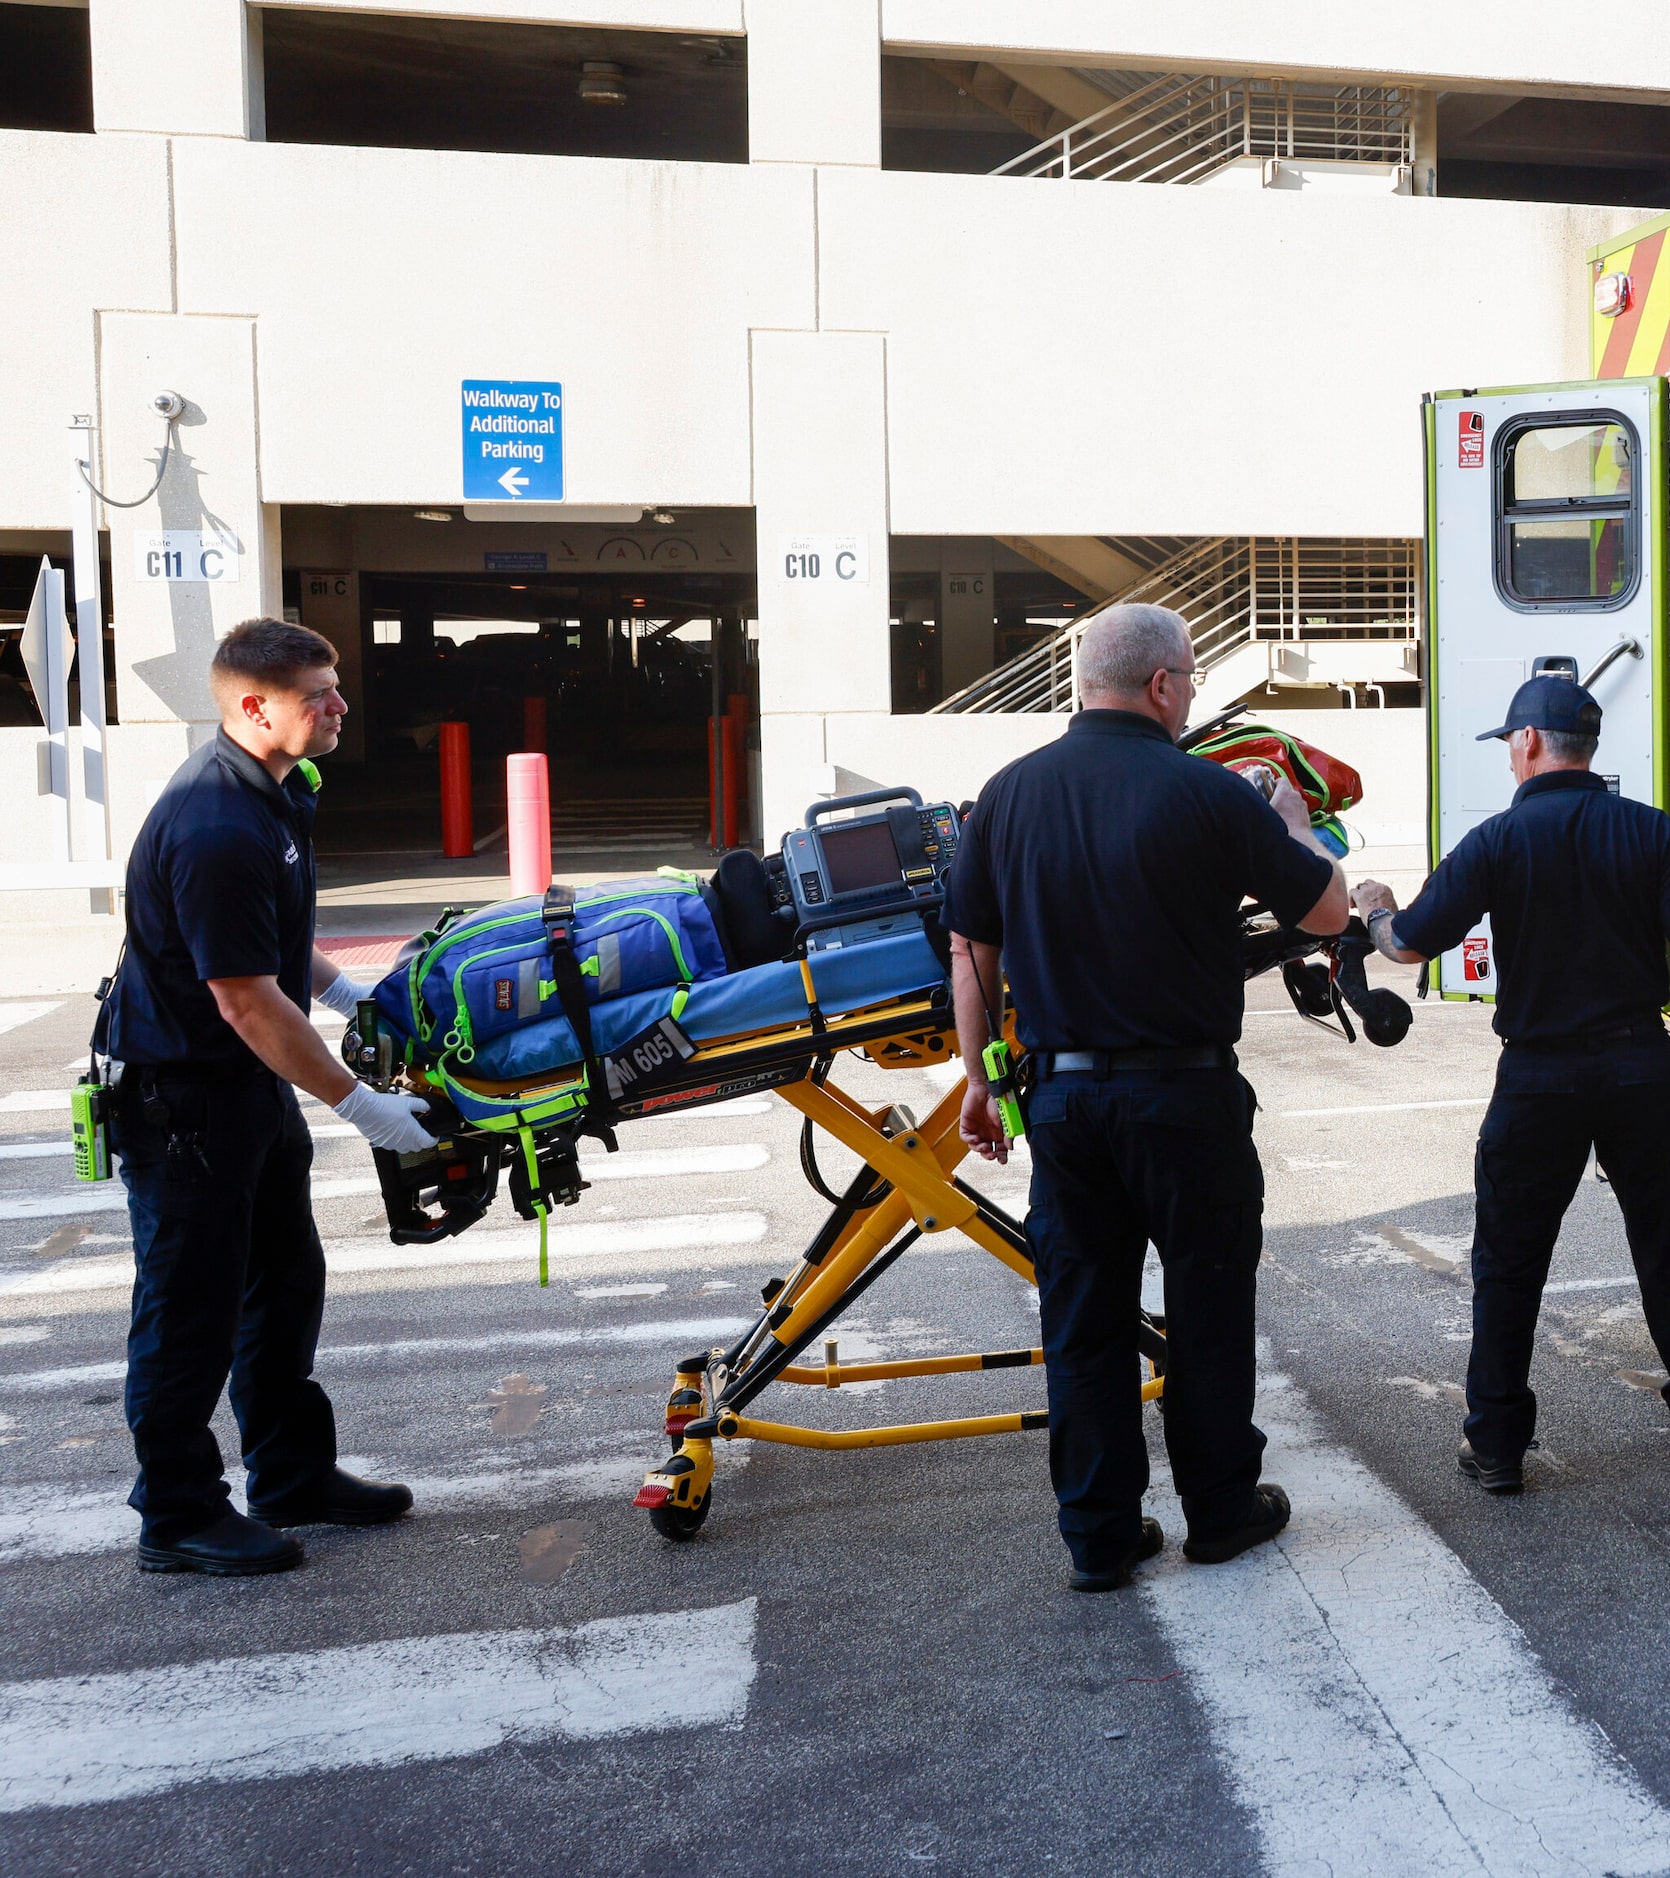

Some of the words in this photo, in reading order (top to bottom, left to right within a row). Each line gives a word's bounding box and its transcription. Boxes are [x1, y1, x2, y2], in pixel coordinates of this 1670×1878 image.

[463, 390, 538, 413] Walkway
[542, 392, 561, 409] To
[470, 415, 555, 434] Additional
[482, 440, 544, 463] Parking
[149, 539, 171, 547] Gate
[147, 551, 182, 577] C11
[200, 549, 224, 580] C
[785, 553, 820, 579] C10
[835, 551, 856, 580] C
[335, 580, 346, 595] C
[973, 580, 984, 594] C
[614, 1057, 638, 1085] M
[633, 1033, 674, 1073] 605
[642, 1084, 721, 1113] power
